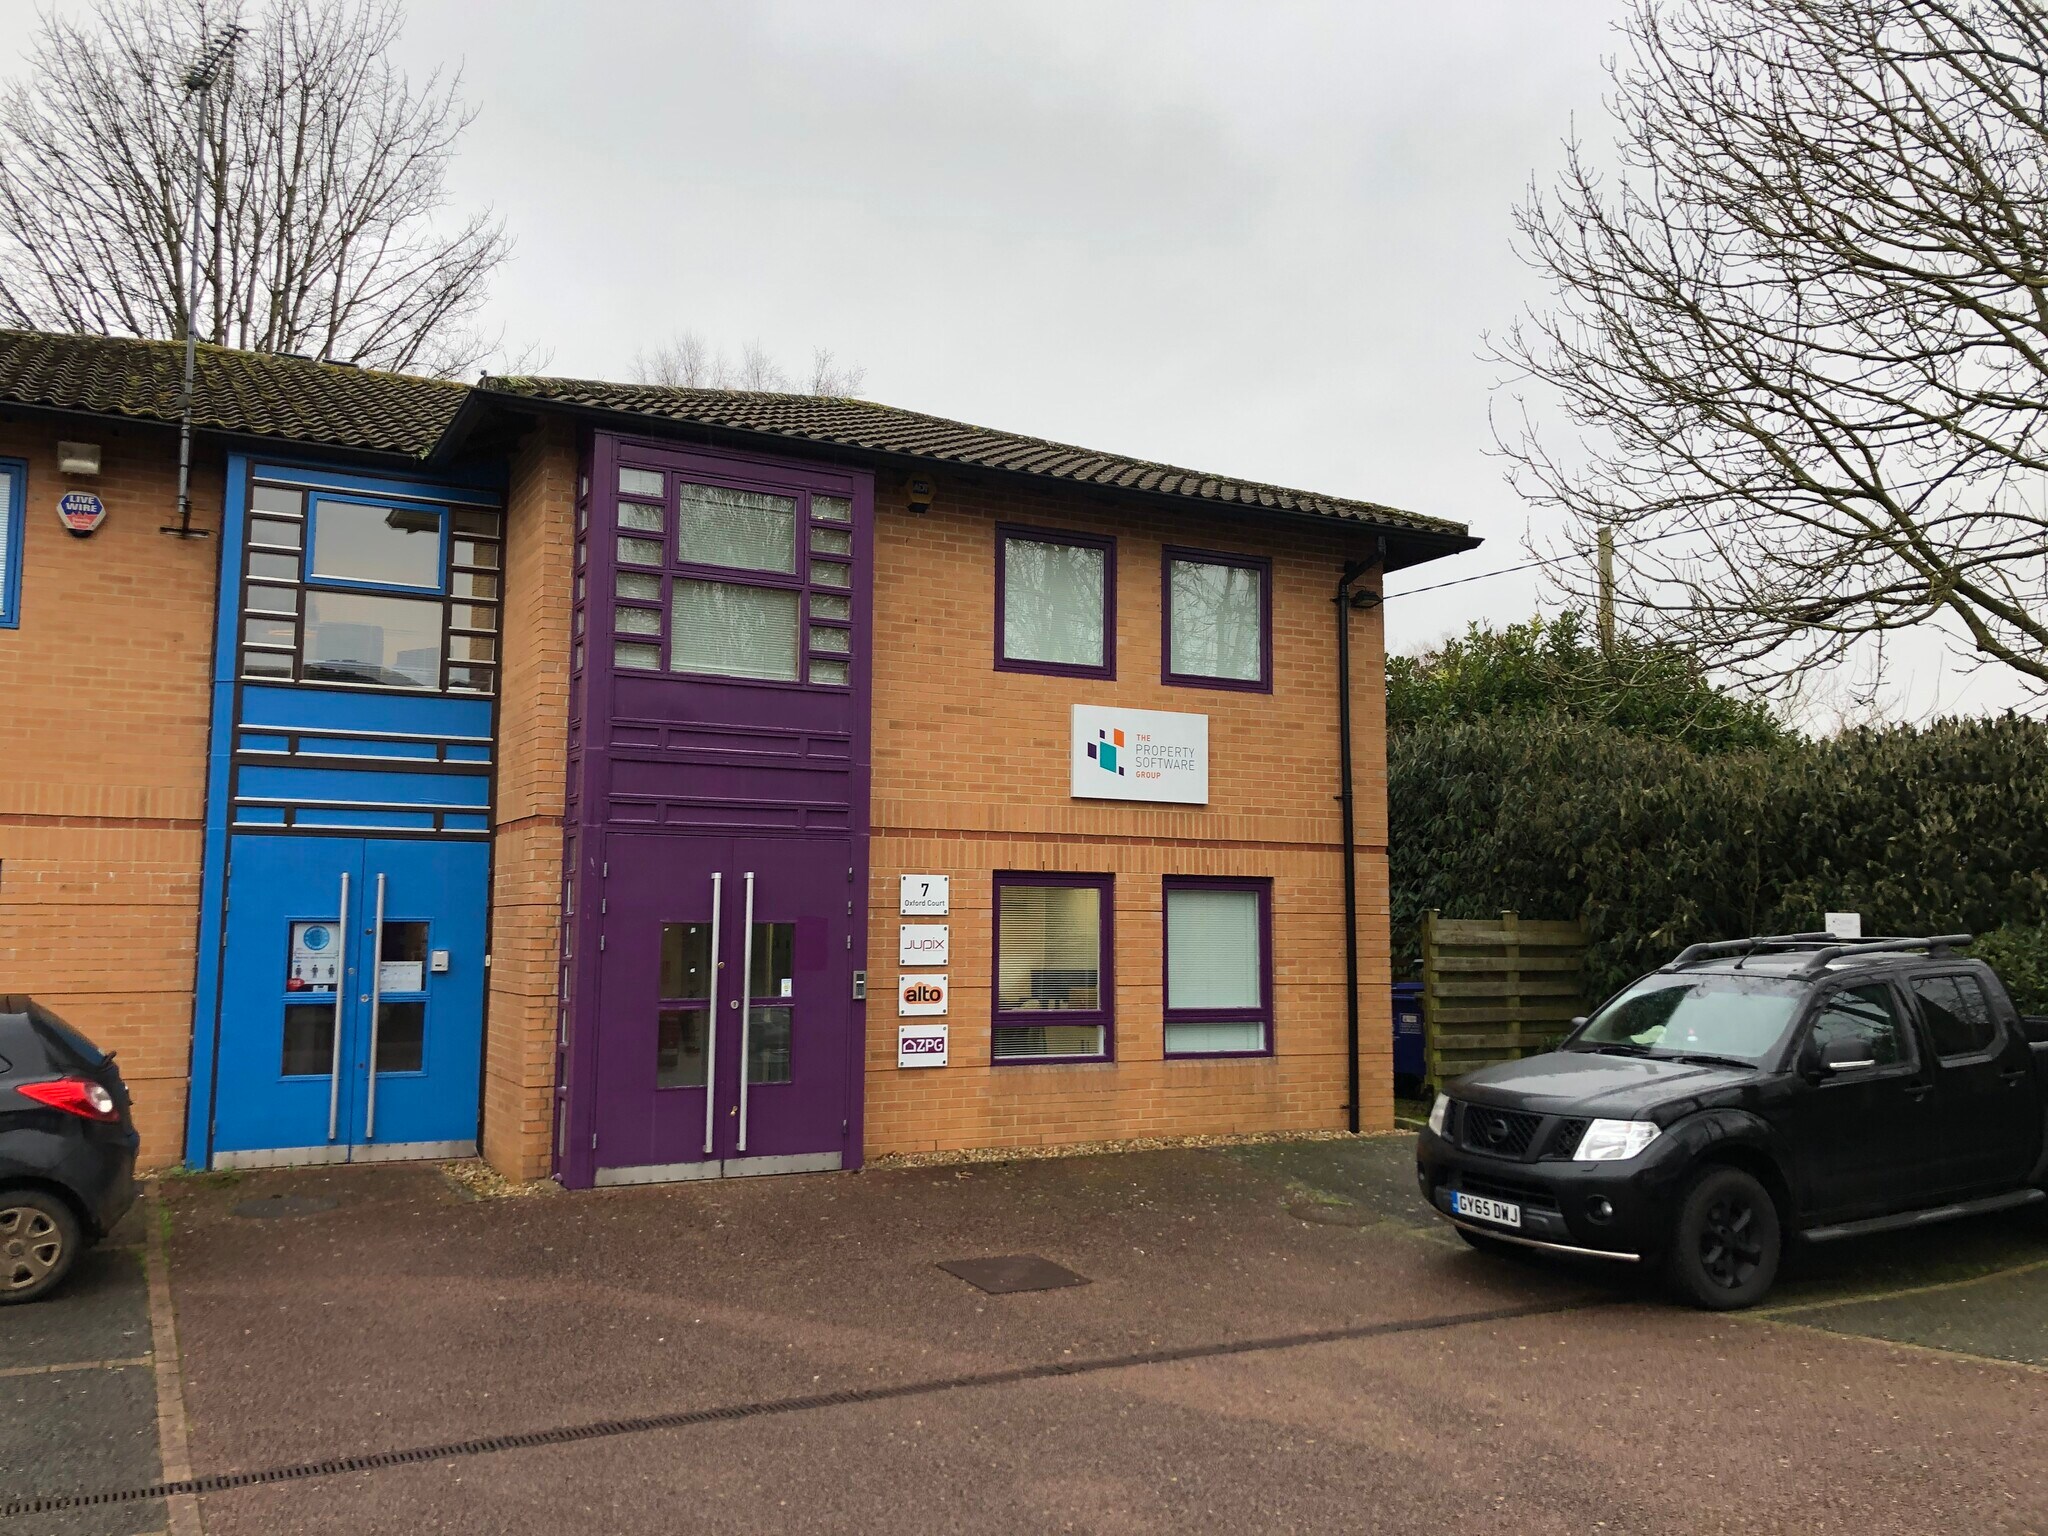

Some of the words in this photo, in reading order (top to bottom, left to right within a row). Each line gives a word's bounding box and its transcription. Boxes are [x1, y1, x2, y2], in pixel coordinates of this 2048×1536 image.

[69, 495, 95, 504] LIVE
[65, 502, 98, 512] WIRE
[1136, 734, 1151, 742] THE
[1135, 744, 1195, 759] PROPERTY
[1135, 757, 1195, 771] SOFTWARE
[1135, 771, 1161, 779] GROUP
[921, 883, 929, 897] 7
[904, 899, 926, 907] Oxford
[927, 899, 945, 907] Court
[905, 985, 941, 1002] alto
[916, 1038, 943, 1052] ZPG
[1460, 1195, 1490, 1216] GY65
[1493, 1203, 1518, 1223] DWJ
